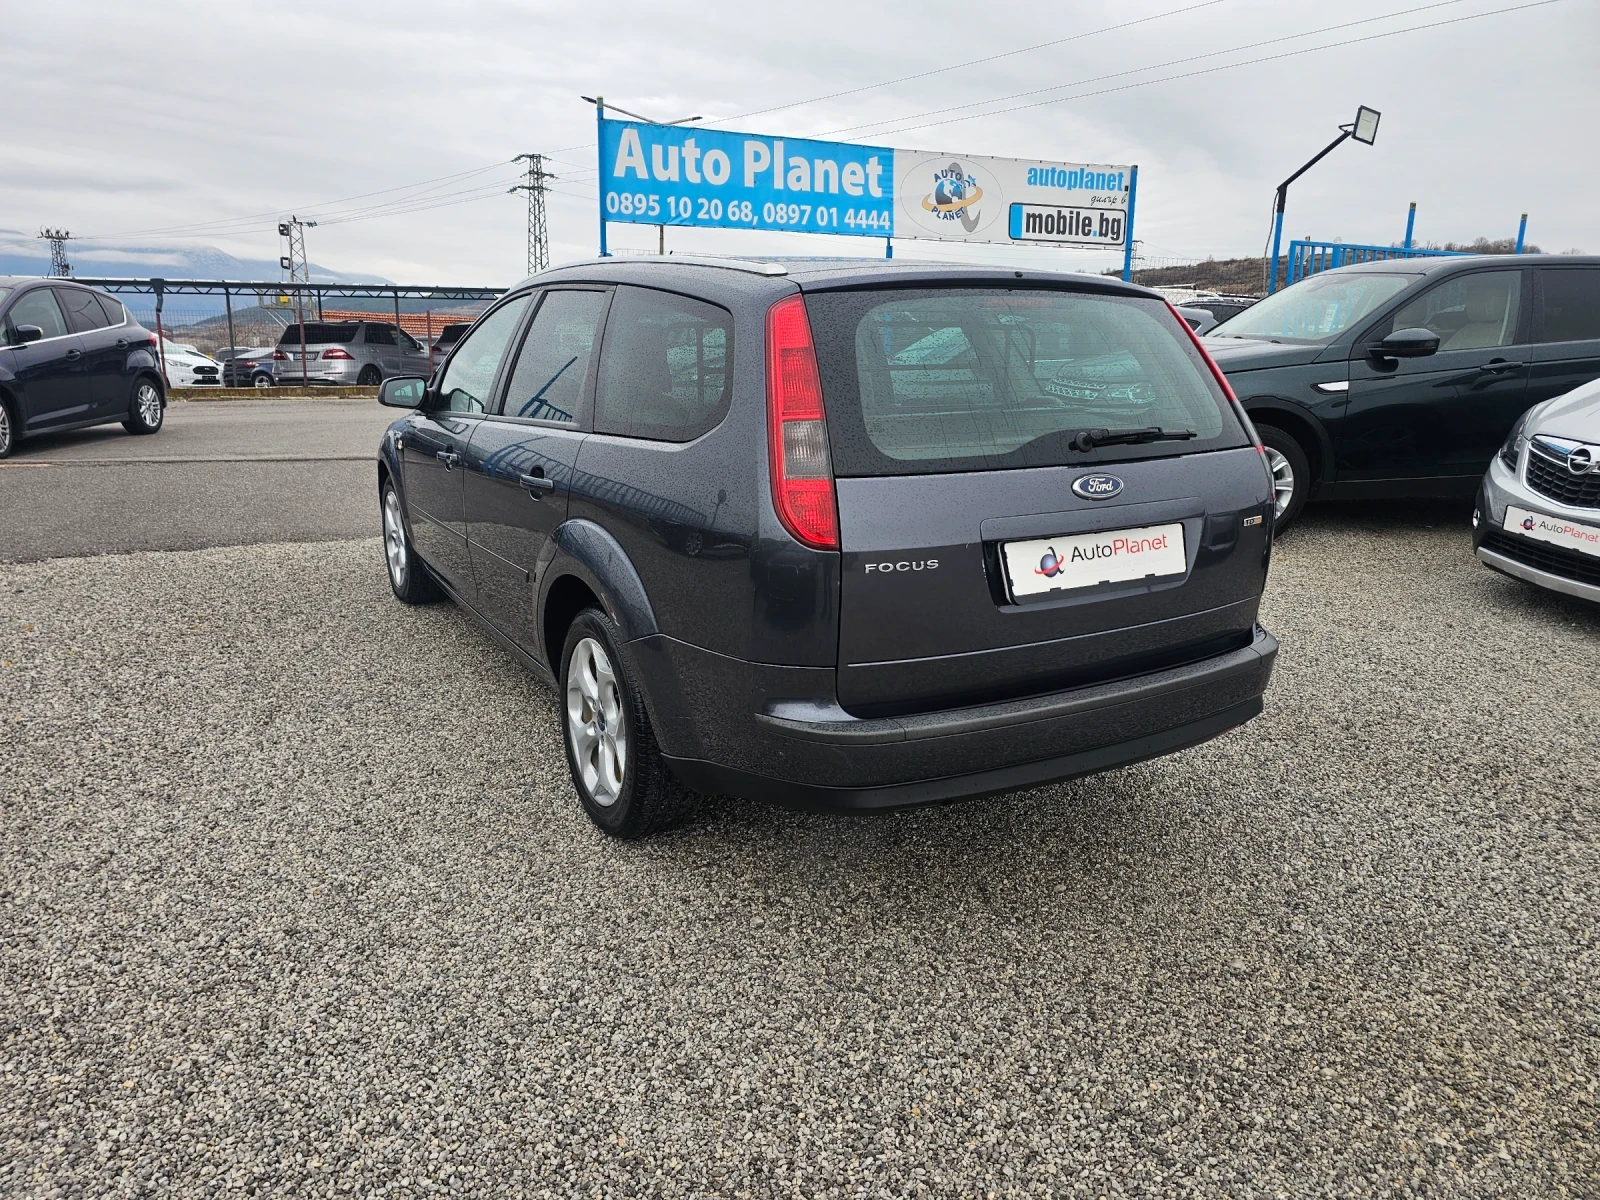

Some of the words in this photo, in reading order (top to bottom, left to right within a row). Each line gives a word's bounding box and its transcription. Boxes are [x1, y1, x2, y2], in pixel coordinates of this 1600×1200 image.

[613, 128, 730, 186] Auto
[744, 140, 882, 198] Planet
[933, 169, 963, 183] AUTO
[606, 191, 659, 216] 0895
[667, 196, 692, 218] 10
[697, 198, 723, 220] 20
[727, 200, 758, 225] 68,
[763, 202, 811, 226] 0897
[816, 206, 838, 227] 01
[844, 208, 890, 230] 4444
[931, 205, 965, 221] PLANET
[1025, 210, 1121, 241] mobile.bg
[1088, 477, 1114, 492] Ford
[1539, 520, 1600, 543] AutoPlanet
[1071, 534, 1168, 562] AutoPlanet
[865, 559, 939, 574] FOCUS
